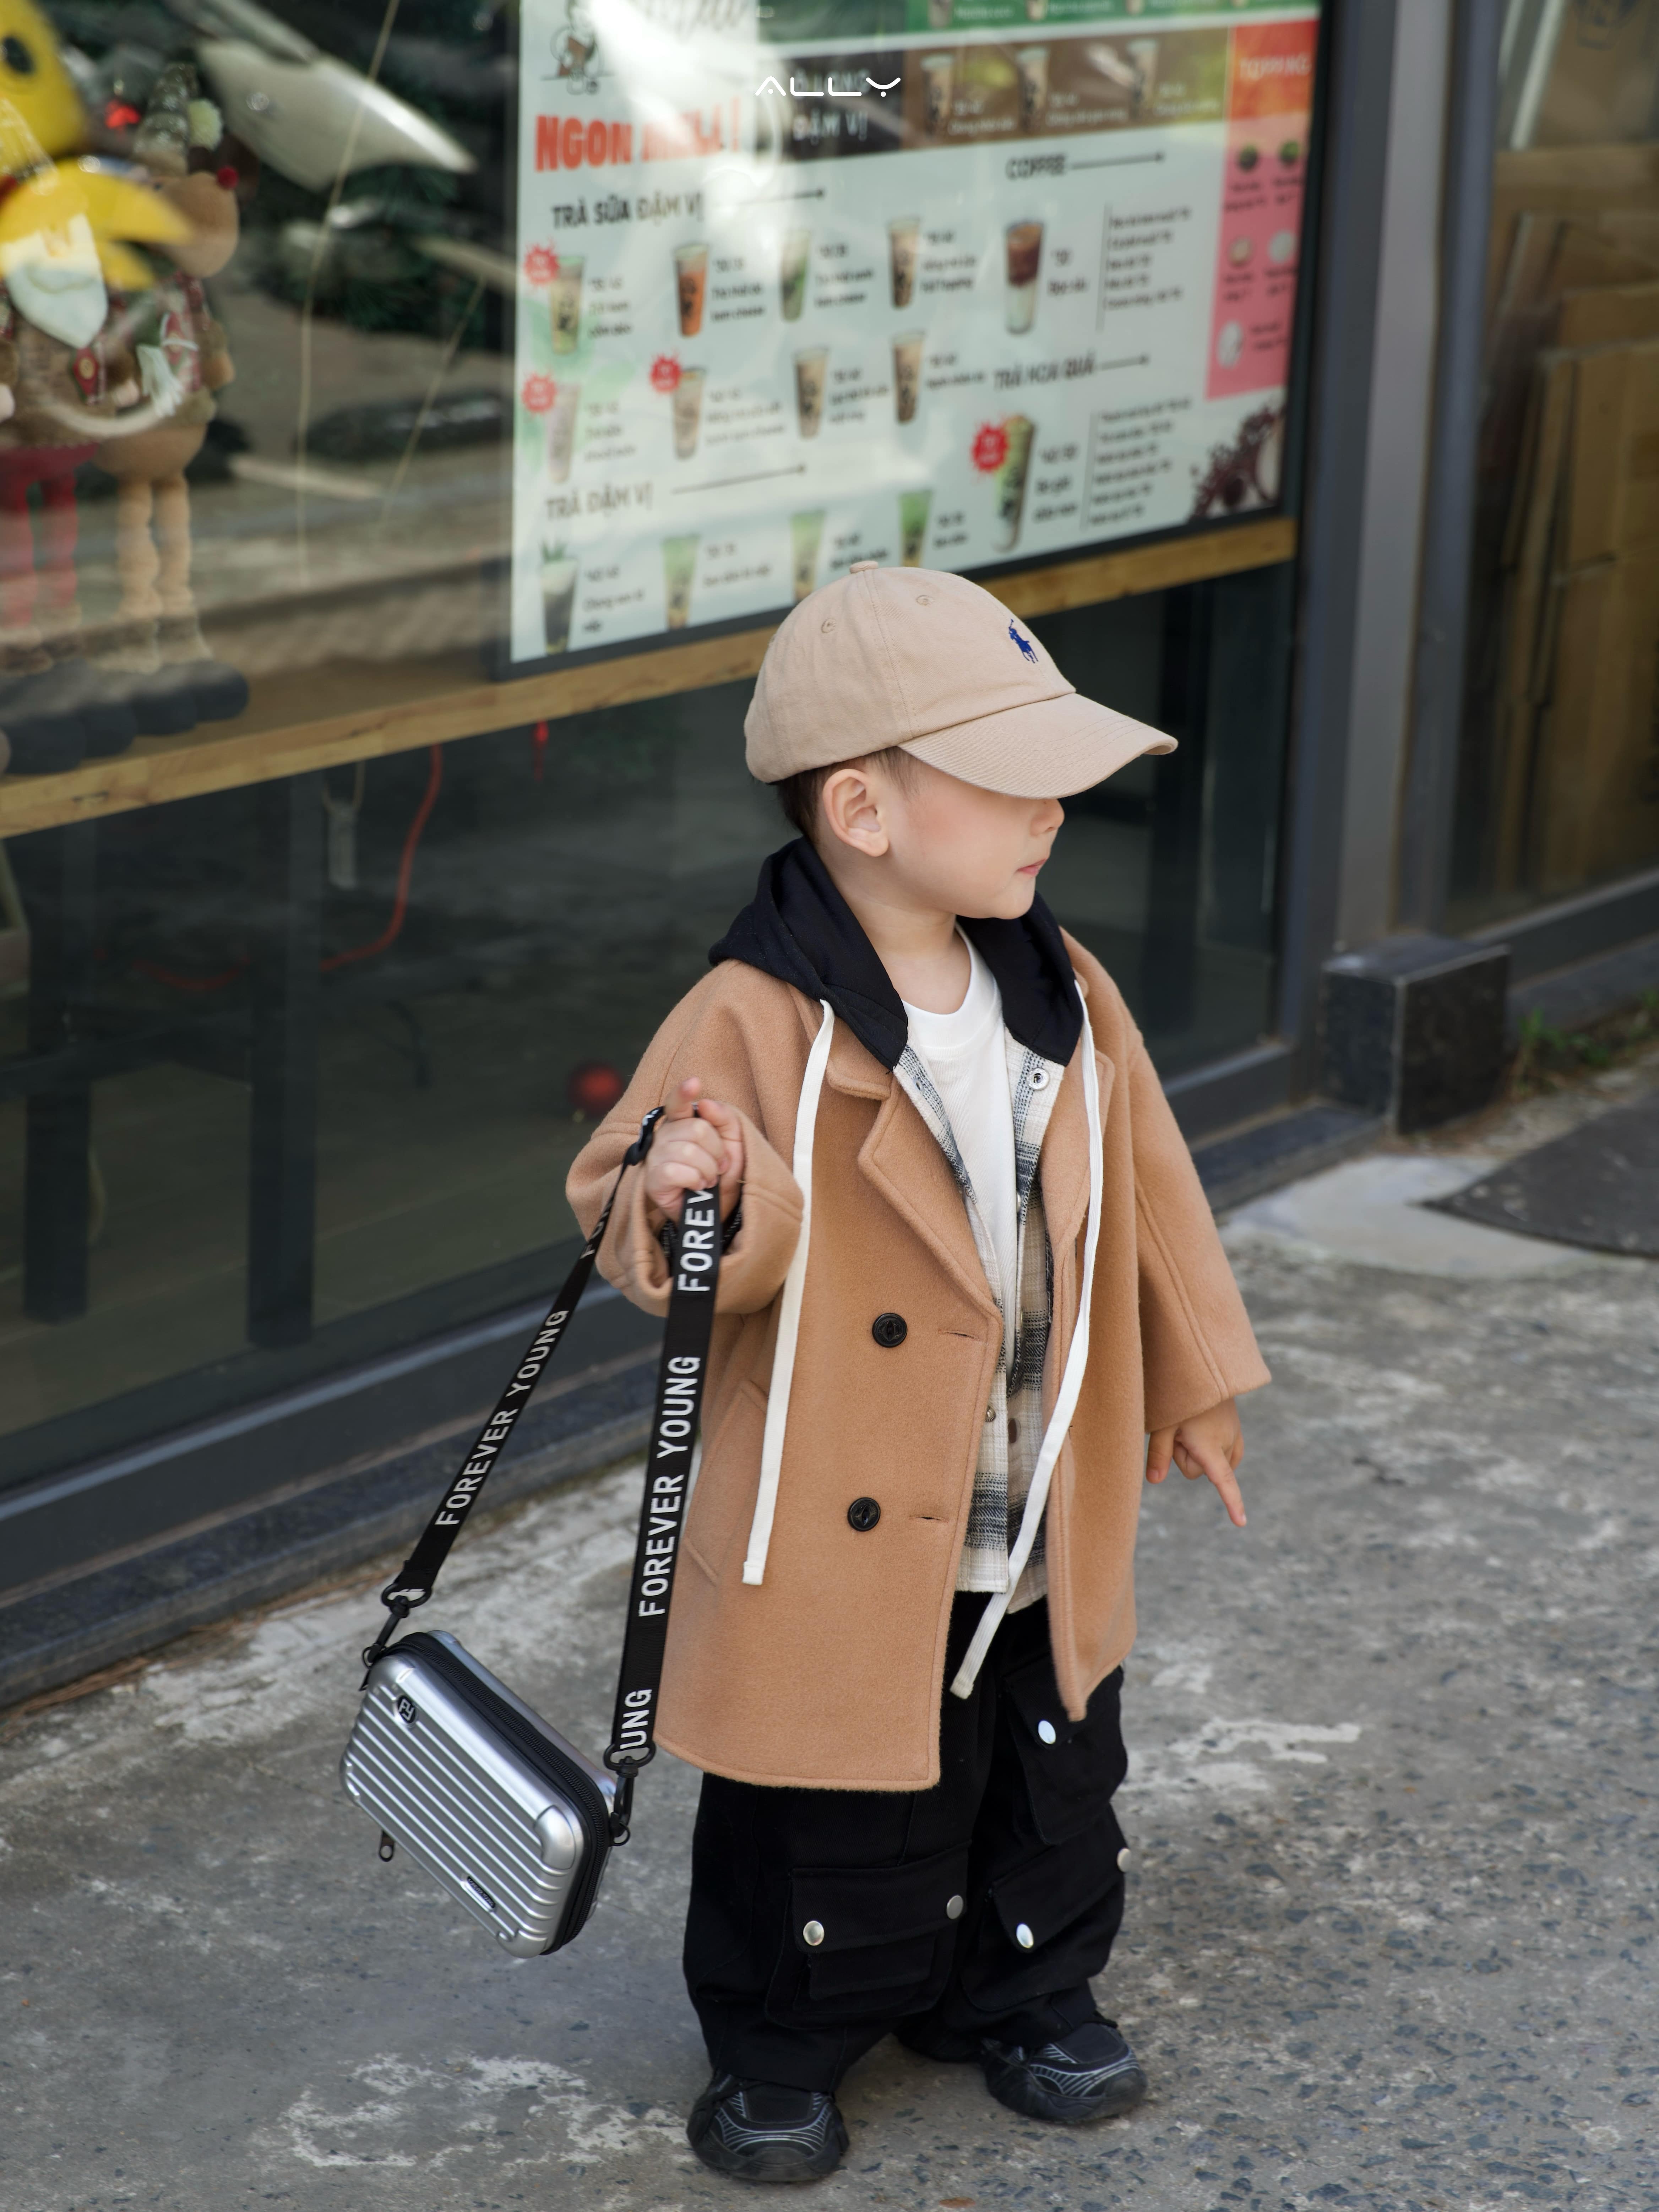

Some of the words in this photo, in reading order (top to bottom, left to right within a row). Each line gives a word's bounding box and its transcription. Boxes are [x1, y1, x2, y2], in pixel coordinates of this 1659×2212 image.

[535, 115, 632, 172] NGON
[552, 196, 588, 229] TRÀ
[594, 191, 631, 224] SỮA
[636, 190, 680, 227] ĐẬM
[683, 191, 705, 222] VỊ
[545, 488, 581, 520] TRÀ
[586, 484, 630, 517] ĐẬM
[635, 481, 653, 510] VỊ
[435, 1408, 518, 1525] FOREVER
[507, 1310, 569, 1397] YOUNG
[657, 1357, 701, 1459] YOUNG
[638, 1474, 685, 1617] FOREVER
